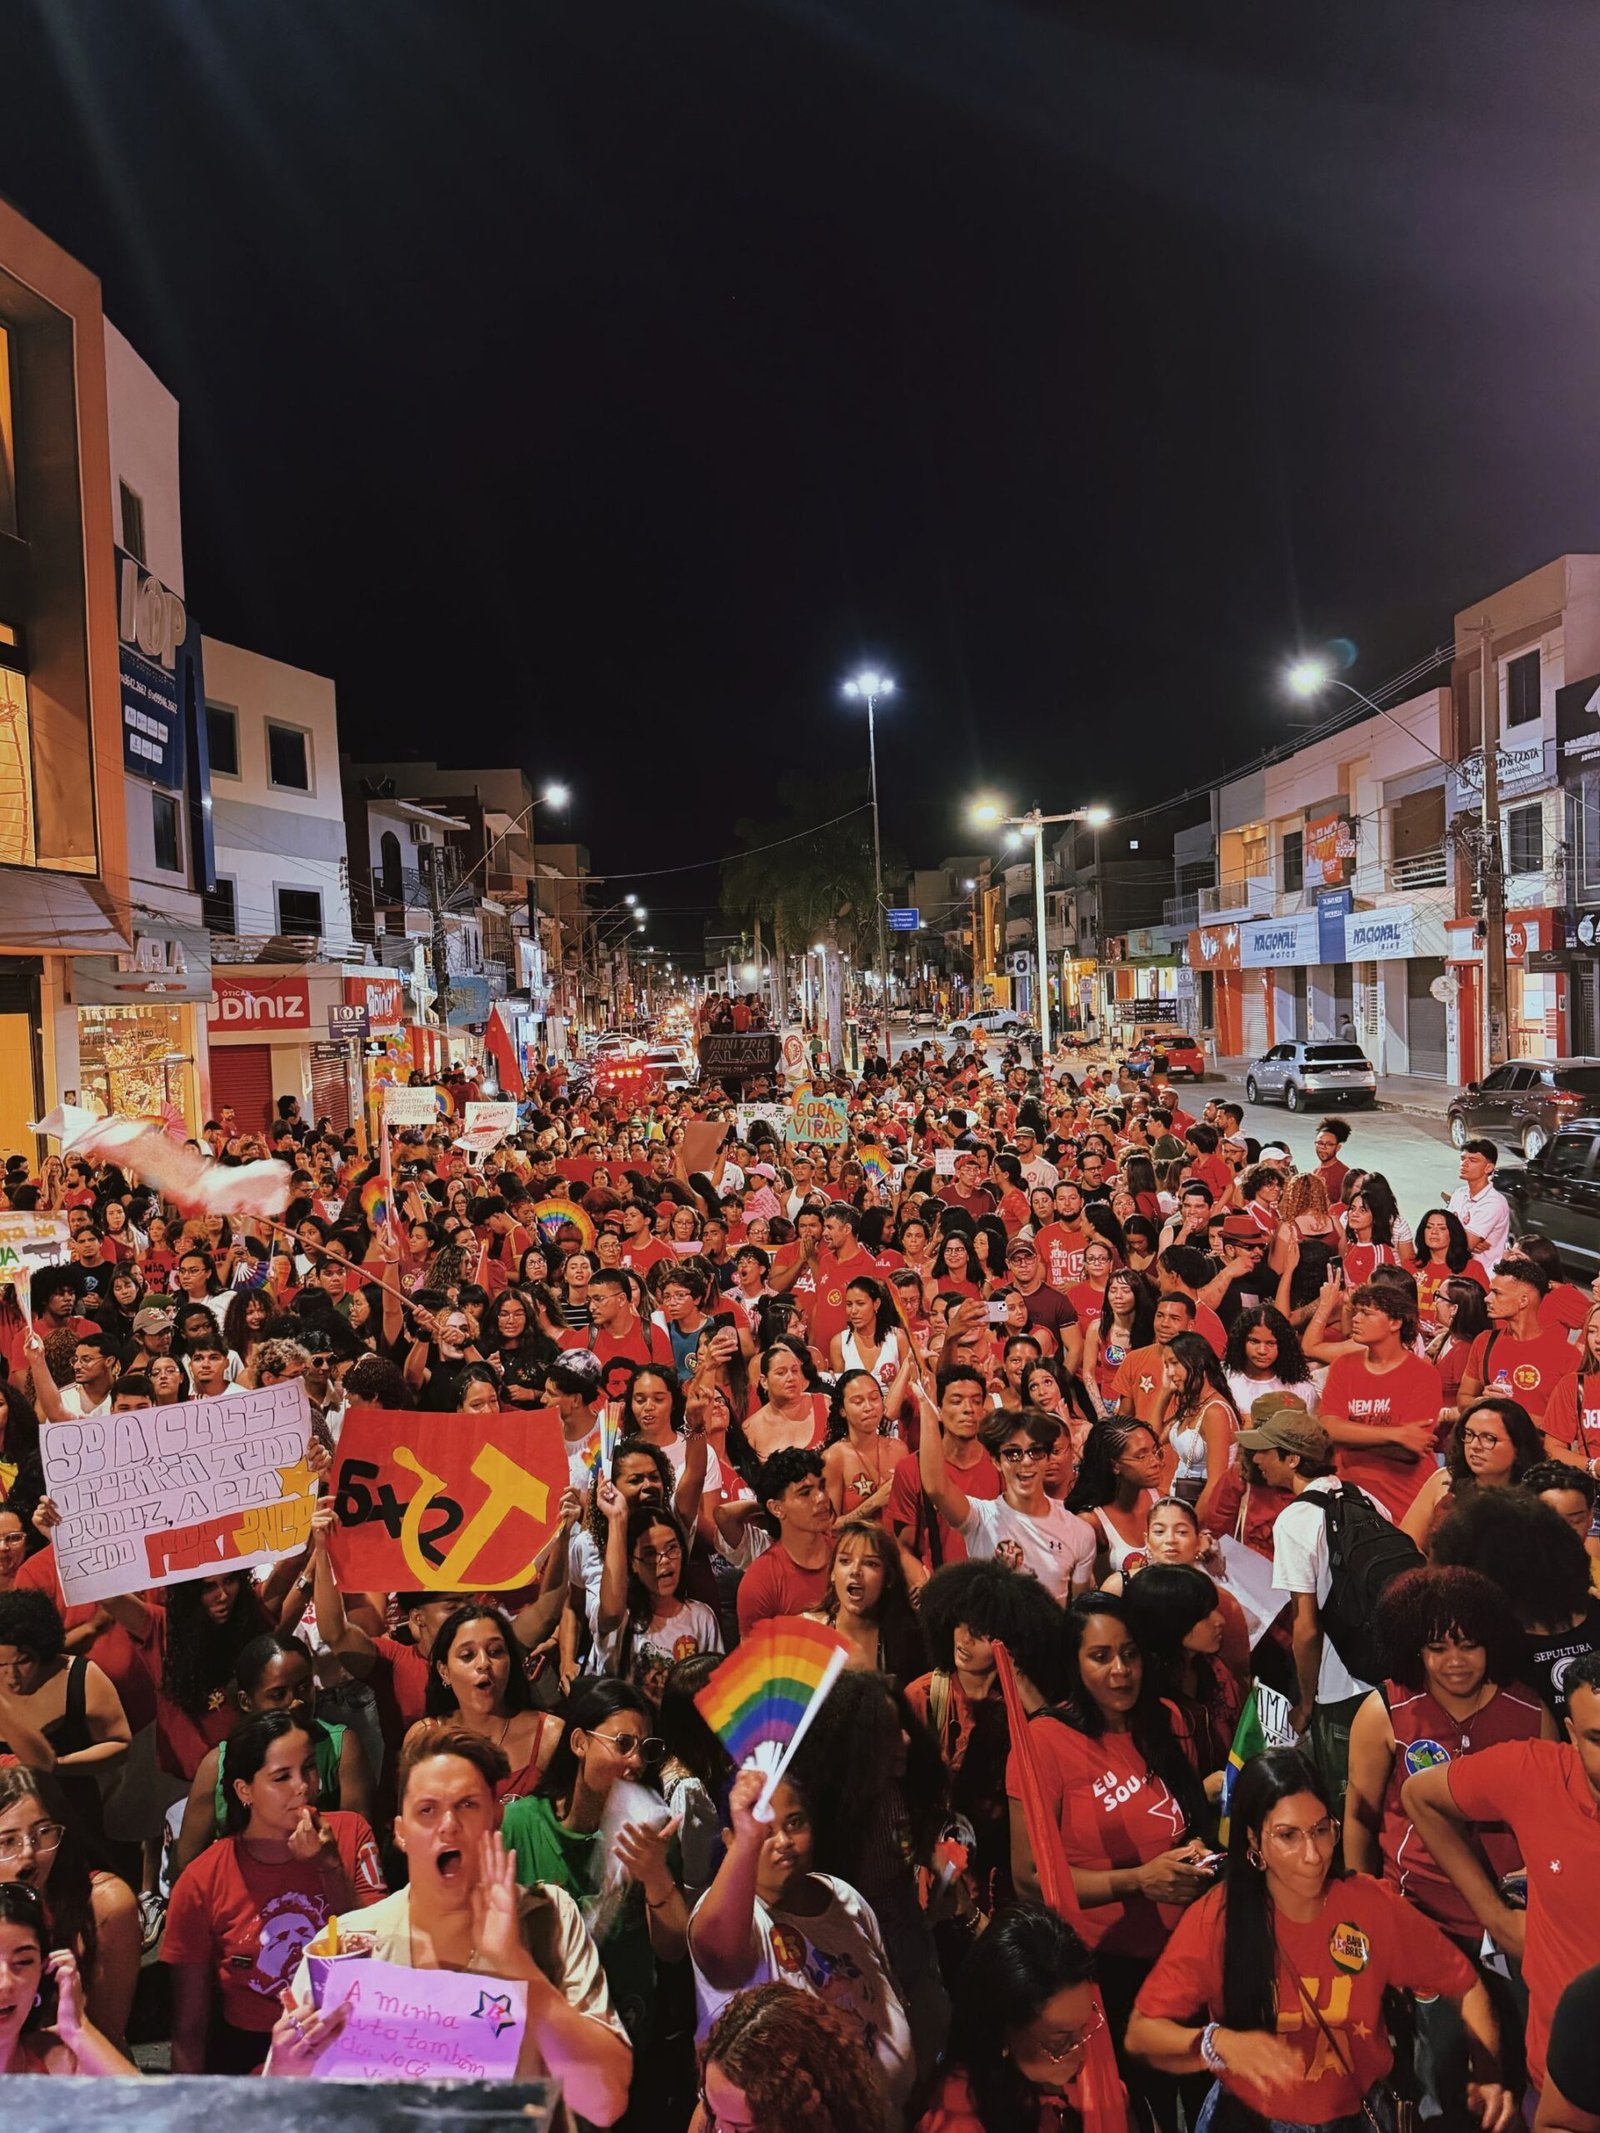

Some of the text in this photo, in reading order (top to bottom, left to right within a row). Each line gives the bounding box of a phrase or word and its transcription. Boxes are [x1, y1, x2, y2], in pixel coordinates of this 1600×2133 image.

[120, 558, 186, 669] IOP
[1254, 930, 1297, 951] NACIONAL
[1353, 923, 1400, 944] NACIONAL
[1270, 950, 1296, 959] MOTOS
[222, 996, 305, 1020] DINIZ
[333, 1006, 365, 1020] IOP
[710, 1038, 769, 1050] MINI TRIO
[707, 1049, 770, 1064] ALAN
[796, 1103, 836, 1120] BORA
[793, 1118, 843, 1139] VIRAR
[1518, 1371, 1535, 1383] 13
[46, 1384, 303, 1483] SE A CLASSE
[51, 1432, 304, 1518] OPERÁRIA TUDO
[56, 1470, 283, 1551] PRODUZ, A ELA
[58, 1539, 136, 1582] TUDO
[677, 1643, 696, 1661] 13
[1533, 1642, 1593, 1663] SEPULTURA
[1092, 1770, 1118, 1798] EU
[344, 1980, 361, 2002] A
